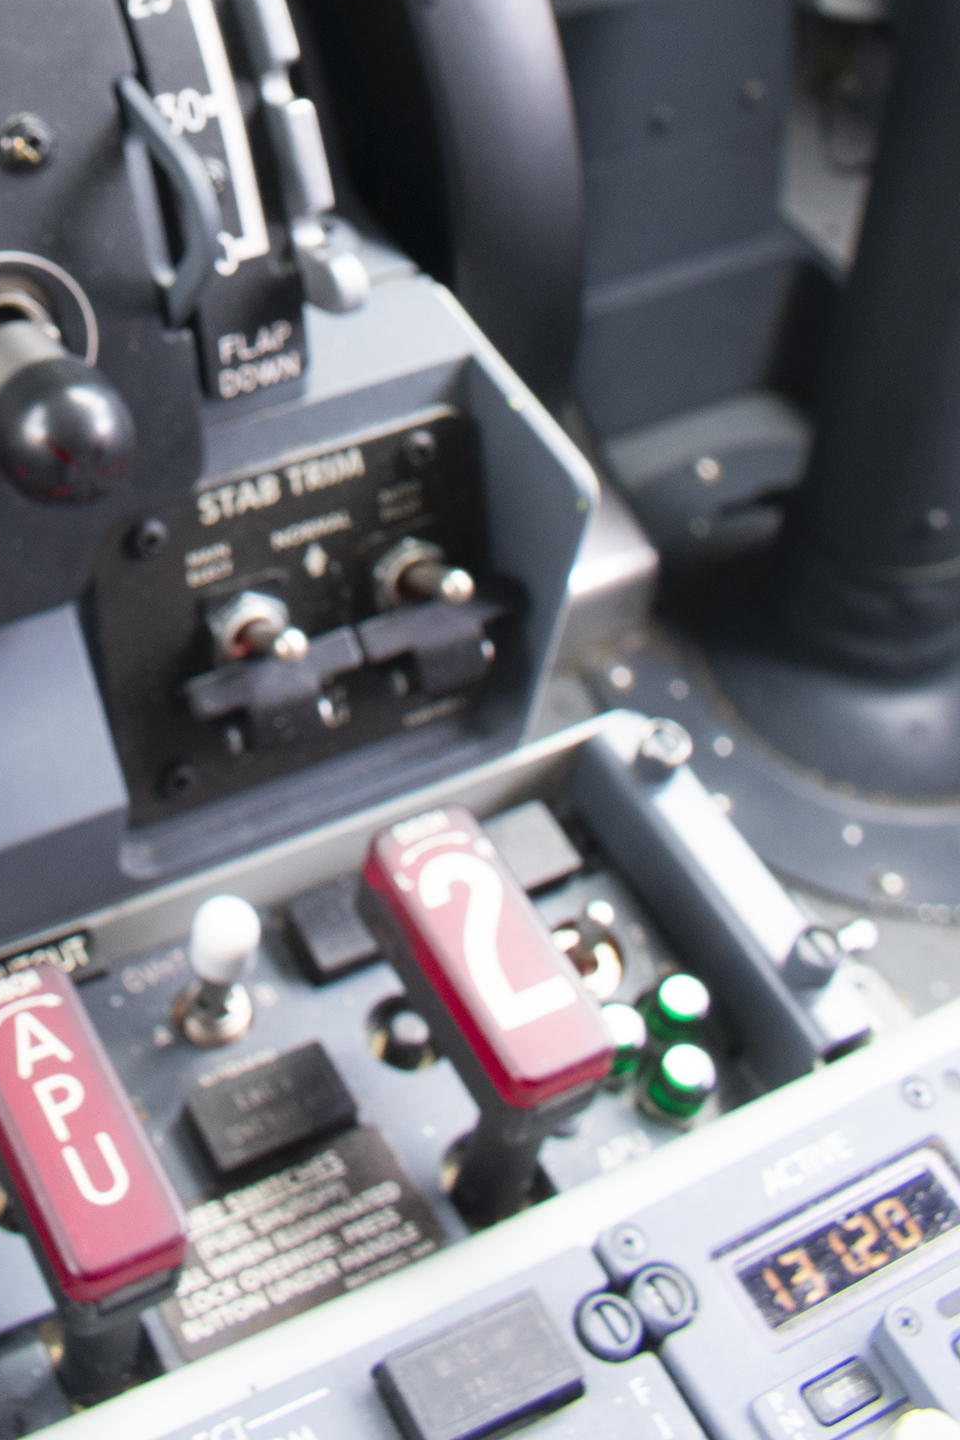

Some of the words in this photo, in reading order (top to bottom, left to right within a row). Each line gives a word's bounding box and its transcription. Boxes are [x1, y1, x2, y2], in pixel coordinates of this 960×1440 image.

[217, 319, 293, 366] FLAP
[217, 350, 302, 400] DOWN
[196, 472, 282, 527] STAB
[285, 446, 367, 498] TRIM
[269, 508, 354, 553] NORMAL
[417, 851, 578, 1032] 2
[13, 1011, 131, 1207] APU
[759, 1128, 855, 1199] ACTIVE
[178, 1276, 241, 1318] LOCK
[180, 1290, 271, 1344] BUTTON
[264, 1257, 341, 1306] UNDER
[340, 1219, 422, 1273] HANDLE
